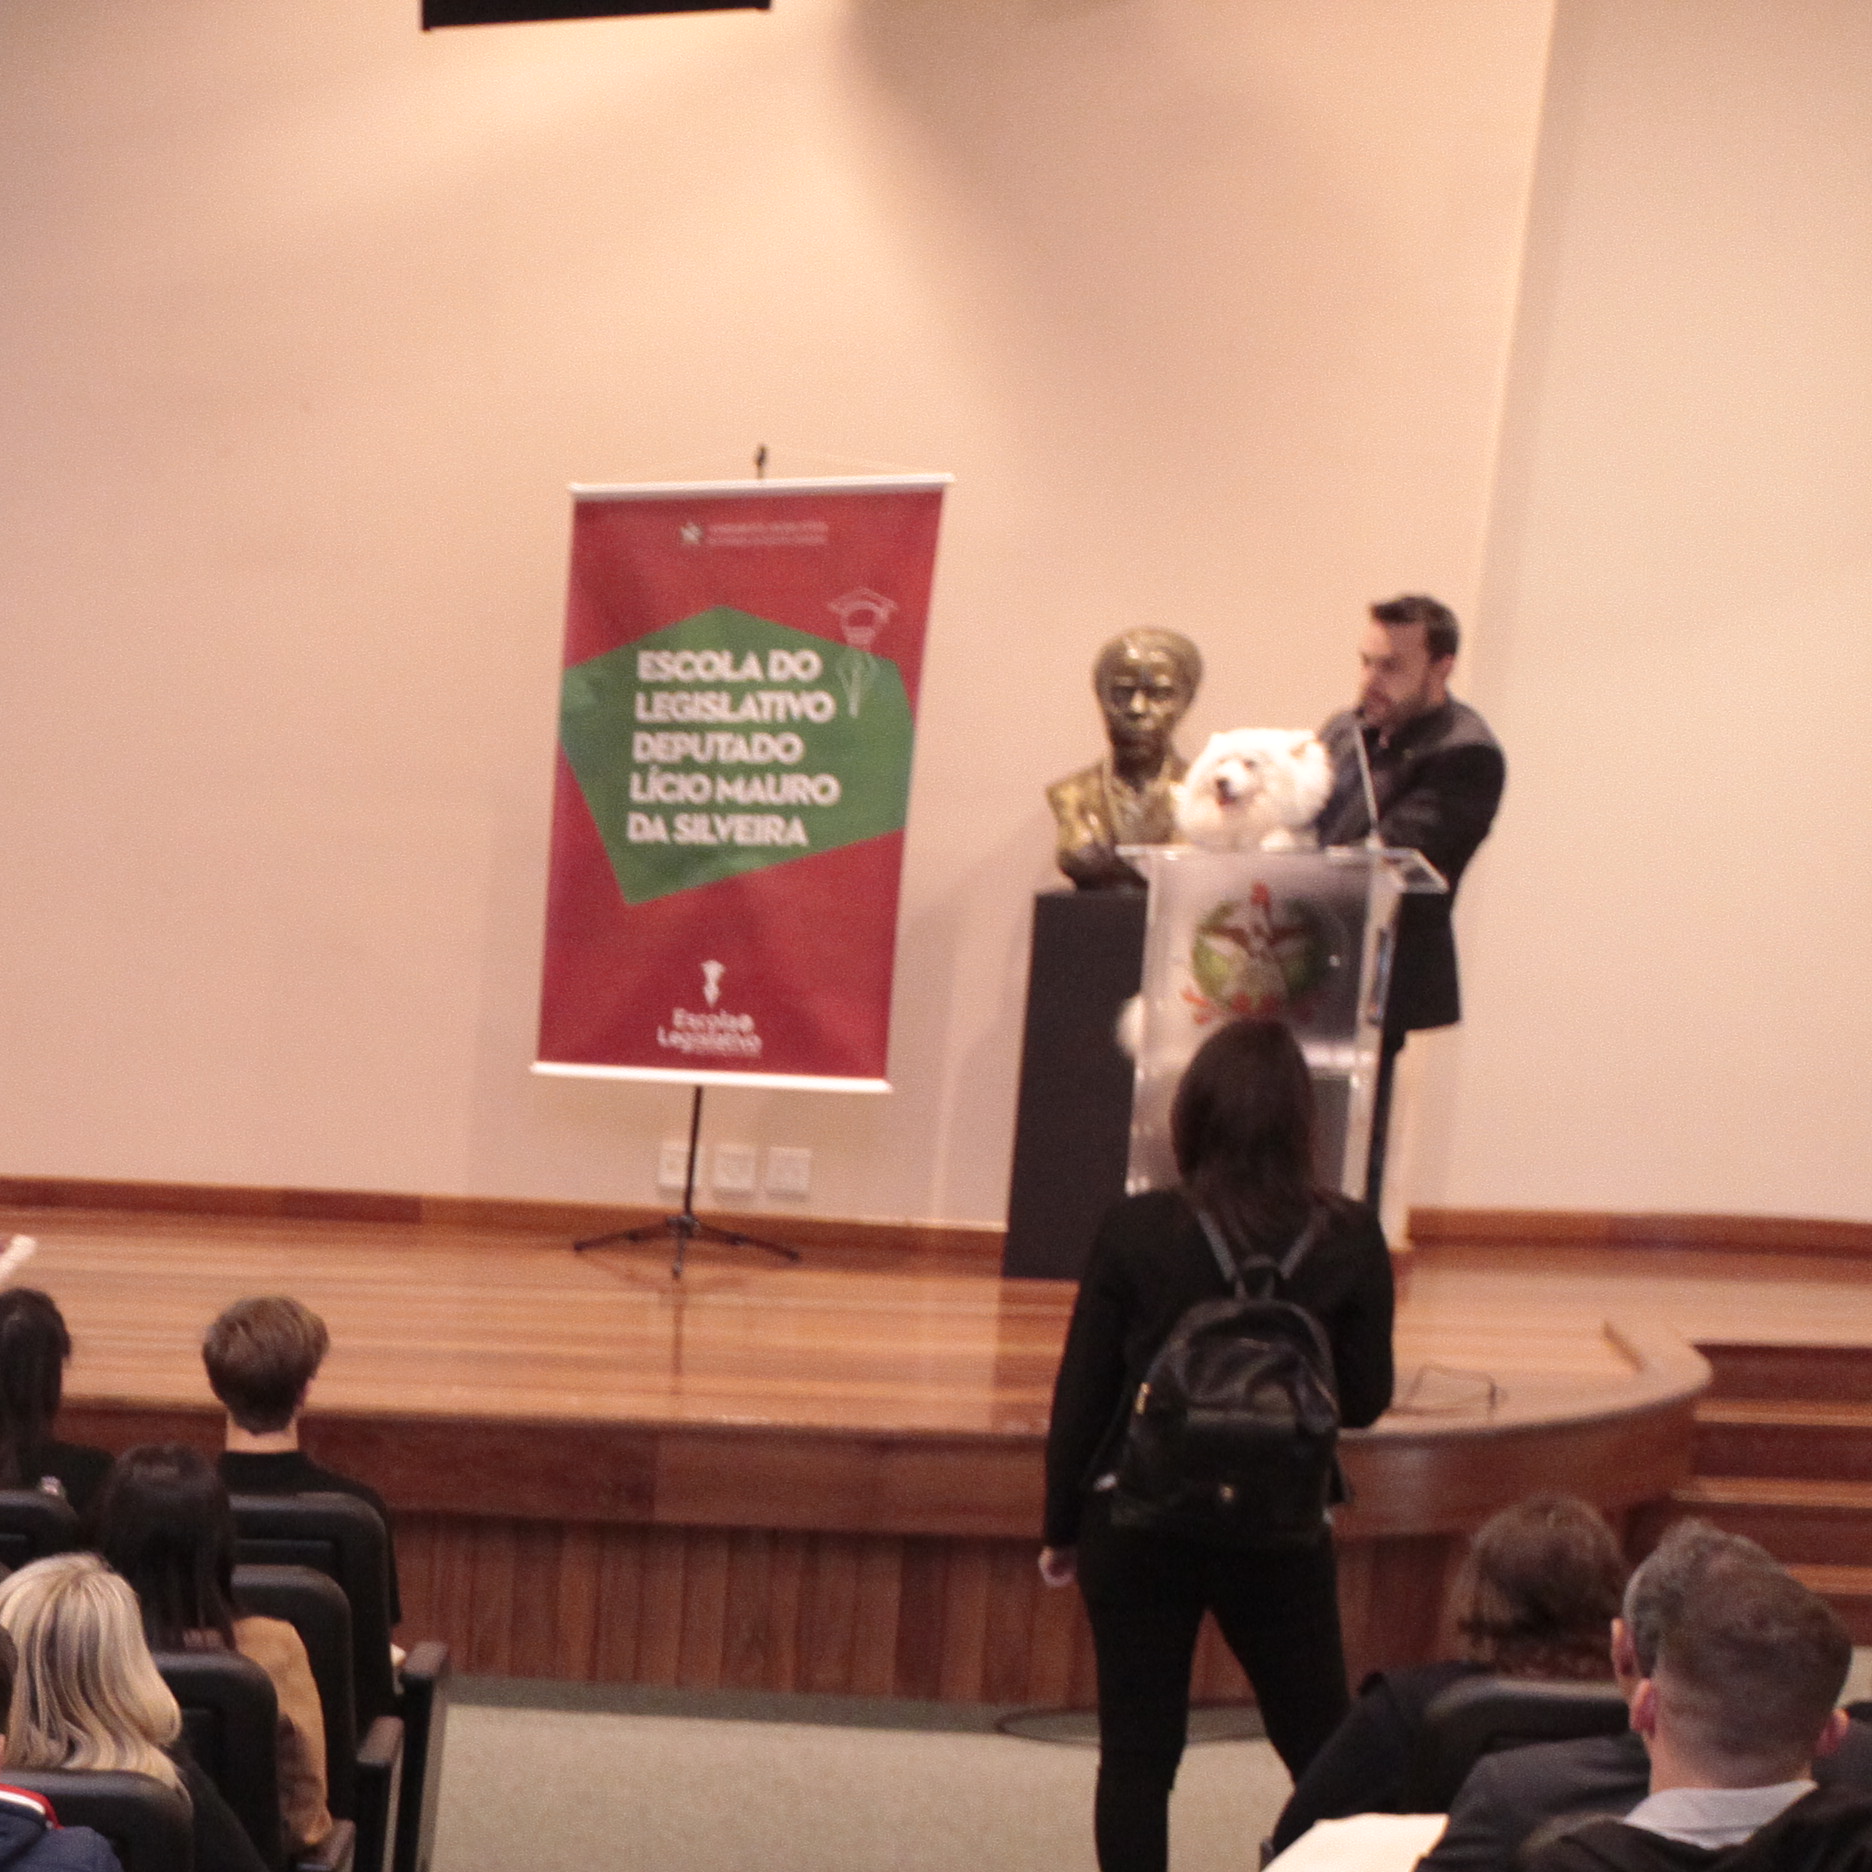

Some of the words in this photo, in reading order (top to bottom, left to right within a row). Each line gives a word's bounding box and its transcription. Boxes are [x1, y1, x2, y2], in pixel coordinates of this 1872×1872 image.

[637, 649, 764, 682] ESCOLA
[767, 649, 824, 682] DO
[634, 690, 838, 723] LEGISLATIVO
[632, 731, 805, 765] DEPUTADO
[629, 765, 713, 805] LÍCIO
[715, 773, 843, 806] MAURO
[627, 812, 670, 844] DA
[672, 812, 809, 847] SILVEIRA
